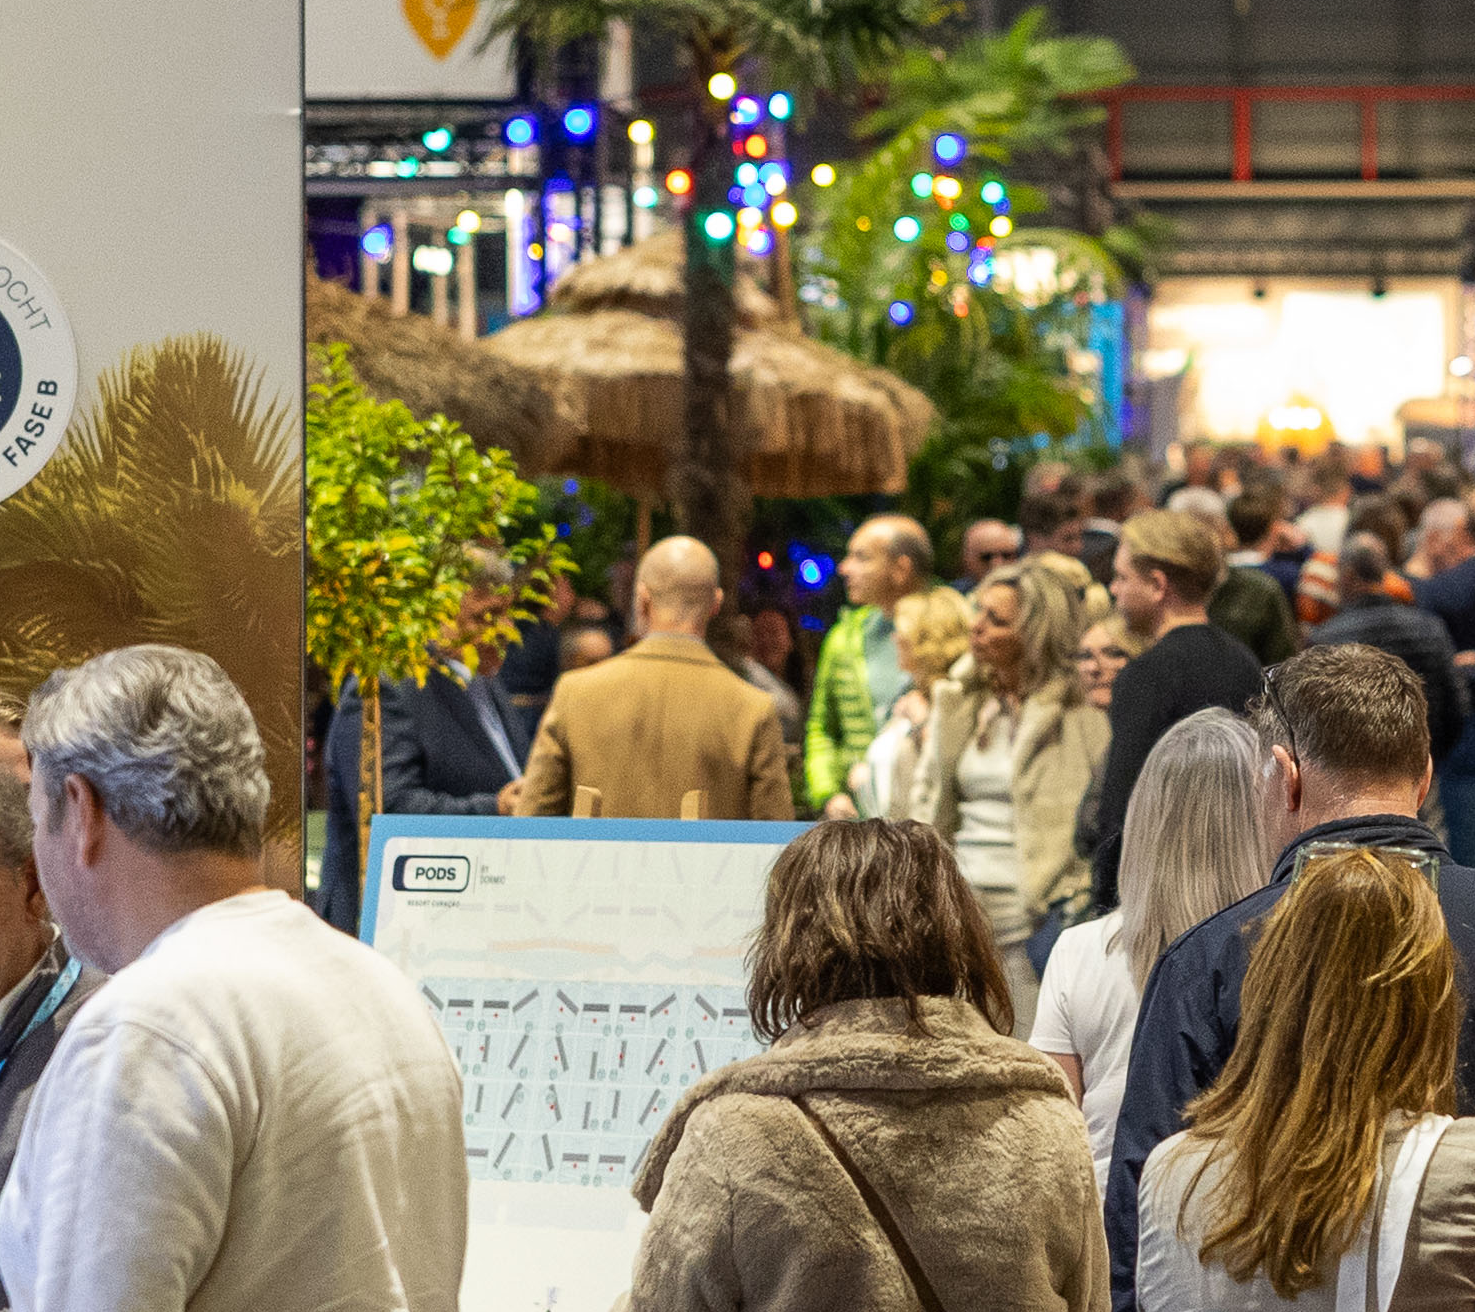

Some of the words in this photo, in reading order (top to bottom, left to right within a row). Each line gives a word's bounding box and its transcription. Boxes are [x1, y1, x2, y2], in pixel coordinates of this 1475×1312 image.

[2, 401, 54, 468] FASE
[37, 378, 59, 397] B
[414, 866, 458, 882] PODS
